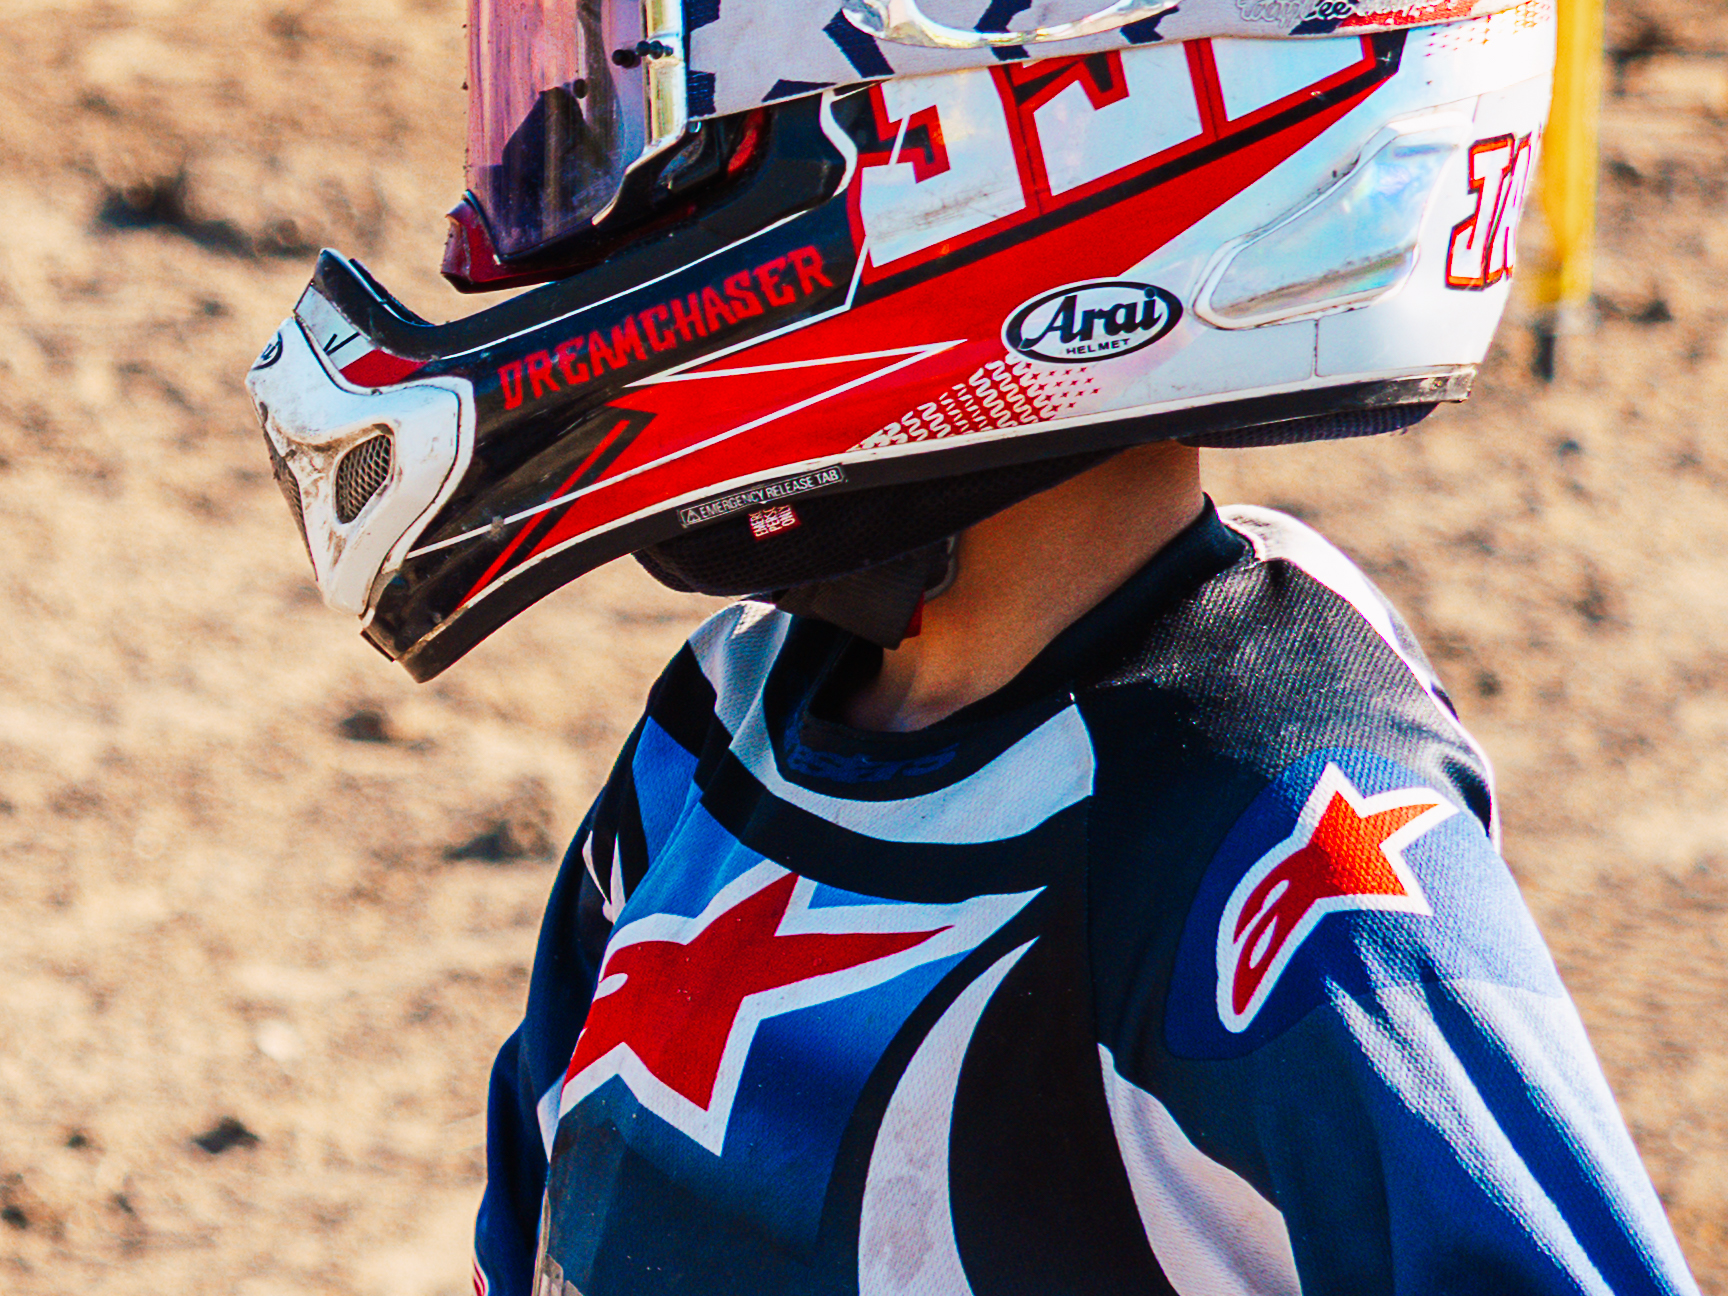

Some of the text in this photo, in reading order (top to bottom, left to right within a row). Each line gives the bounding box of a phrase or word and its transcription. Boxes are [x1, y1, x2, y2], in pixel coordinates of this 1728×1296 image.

[497, 245, 833, 410] DREAMCHASER
[1018, 287, 1164, 349] Arai
[1066, 337, 1131, 355] HELMET
[700, 469, 840, 519] EMERGENCY RELEASE TAB
